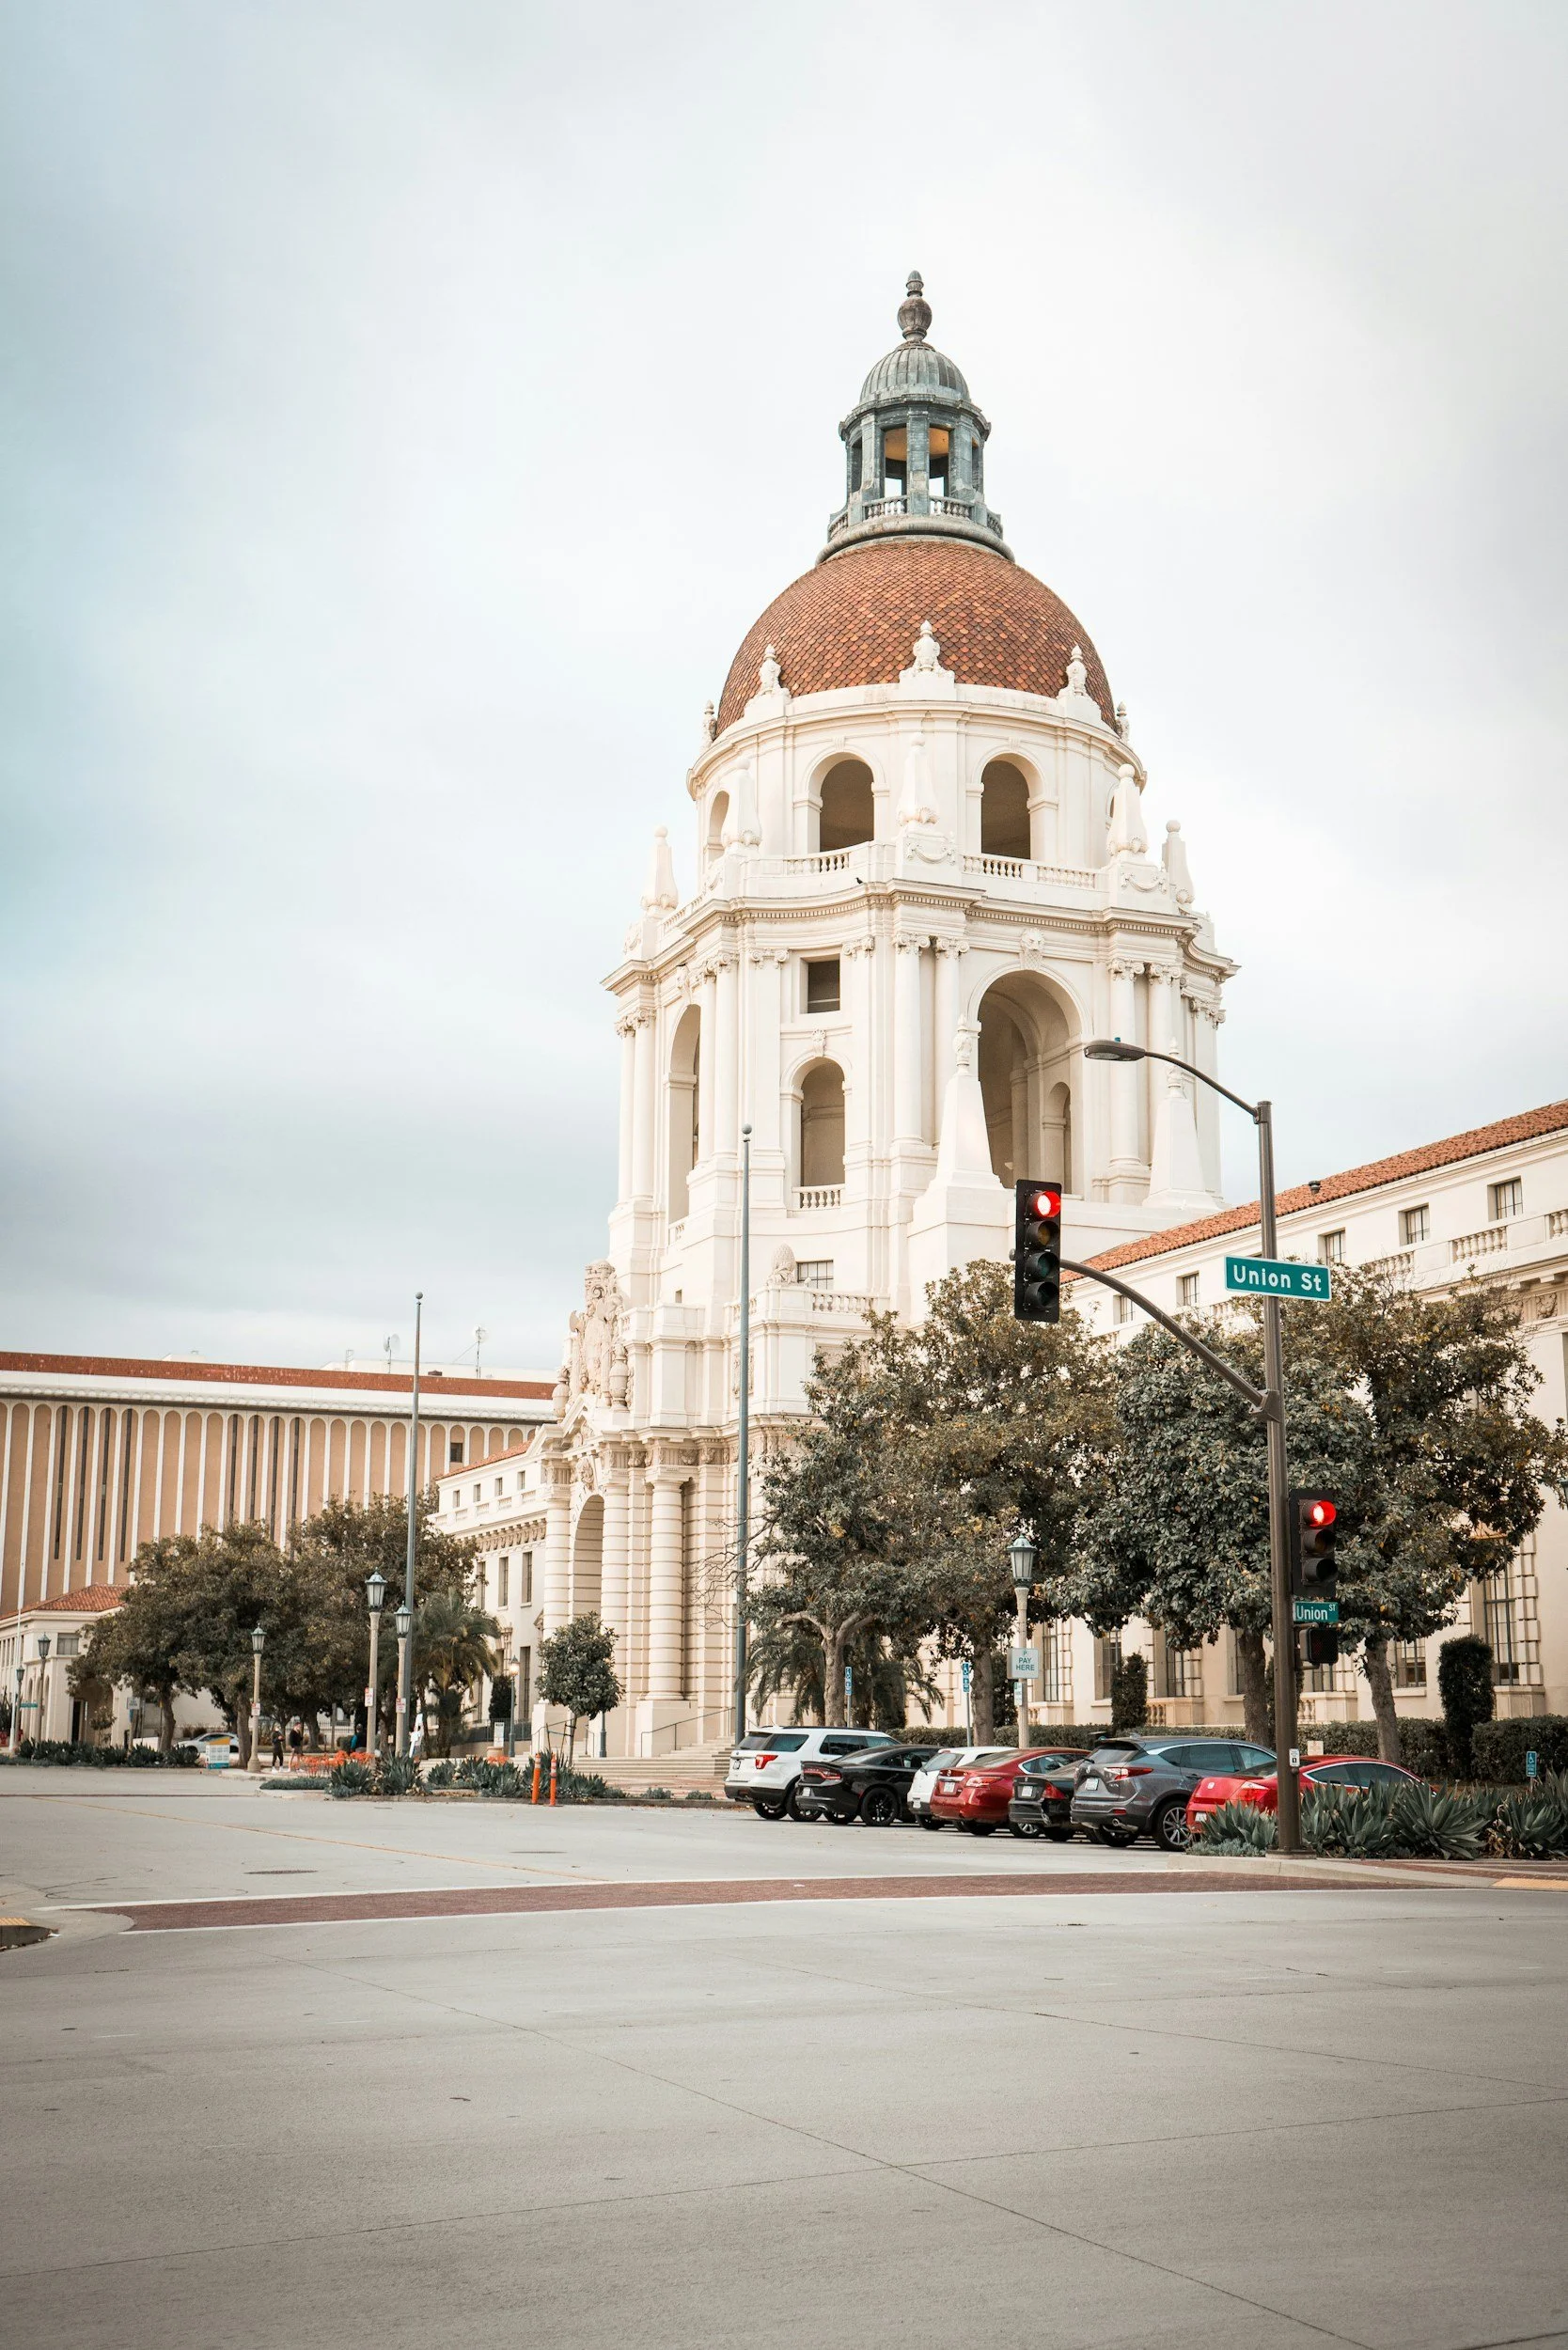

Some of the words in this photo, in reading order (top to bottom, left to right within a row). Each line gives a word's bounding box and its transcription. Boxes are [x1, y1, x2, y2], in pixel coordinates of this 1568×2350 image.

[1233, 1264, 1291, 1289] Union
[1301, 1272, 1322, 1292] St
[1297, 1605, 1328, 1621] Union
[1328, 1604, 1336, 1612] ST
